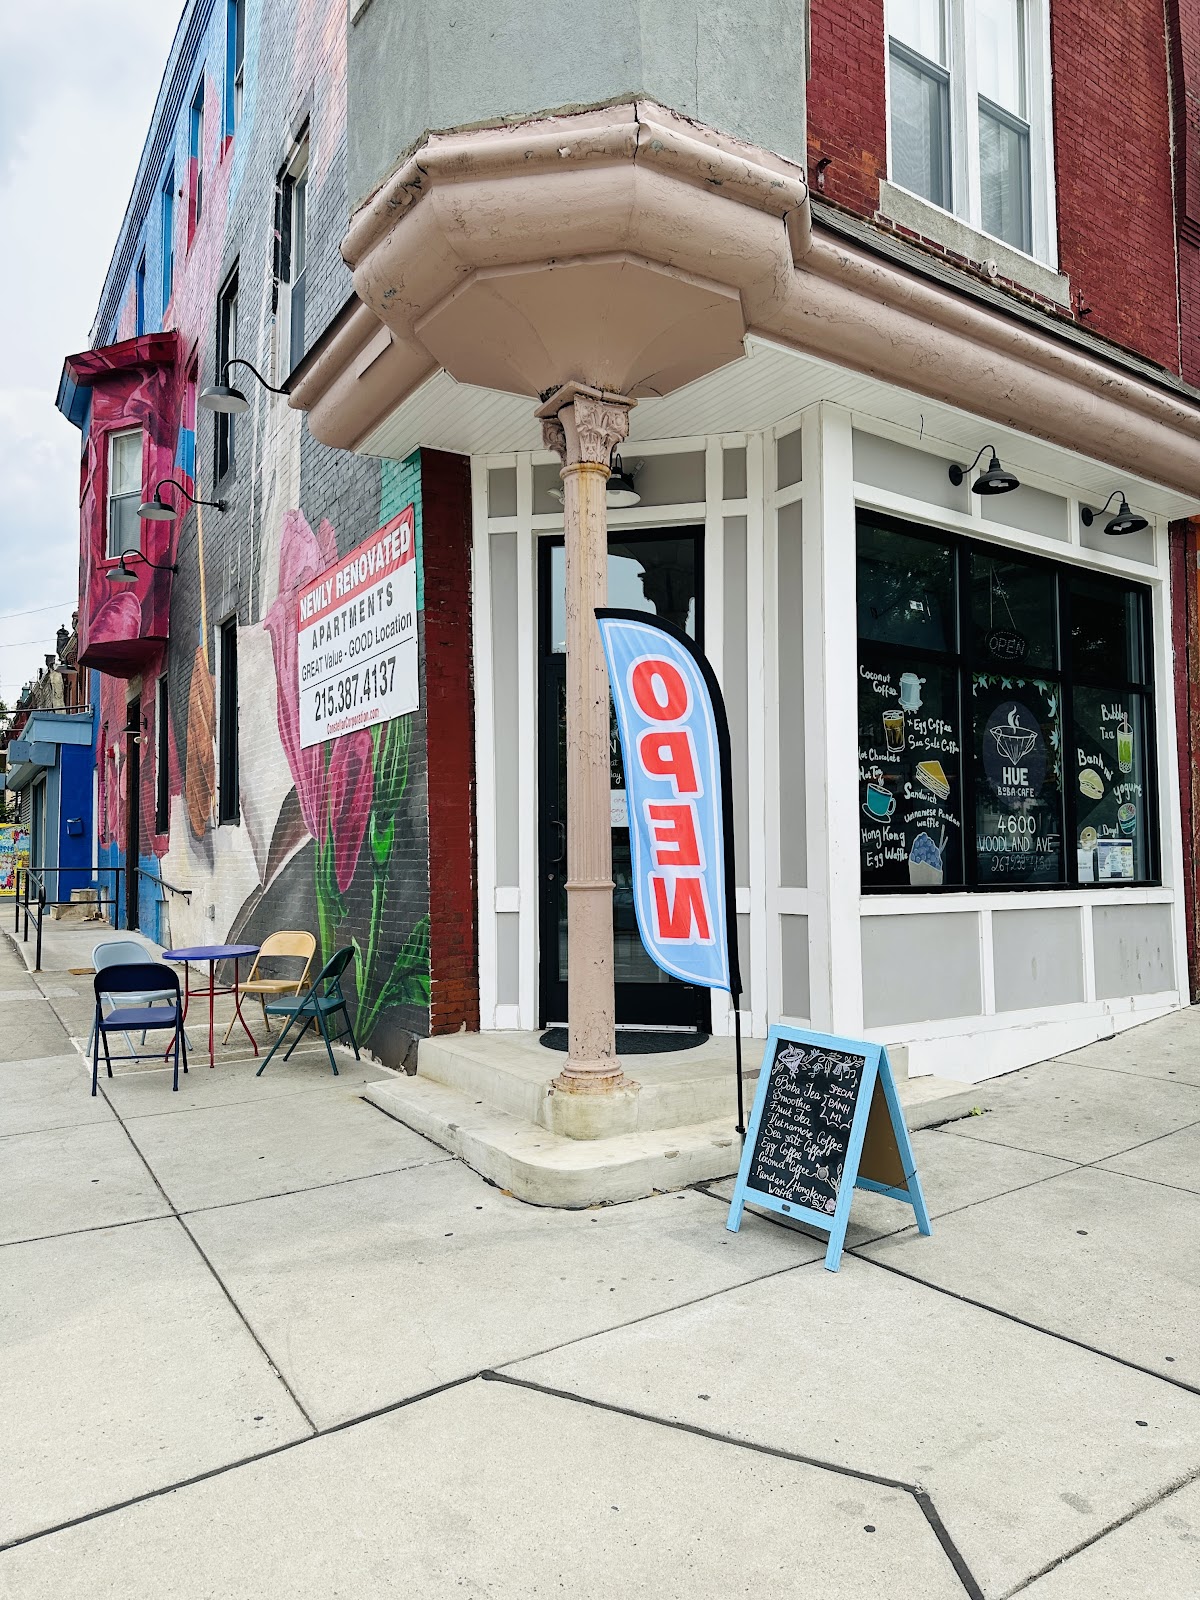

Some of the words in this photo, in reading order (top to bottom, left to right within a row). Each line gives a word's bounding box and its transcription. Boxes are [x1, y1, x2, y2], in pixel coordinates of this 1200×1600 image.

[300, 577, 333, 622] NEWLY
[335, 521, 411, 599] RENOVATED
[311, 581, 393, 650] APARTMENTS
[302, 656, 323, 682] GREAT
[324, 649, 343, 670] Value
[349, 629, 373, 658] GOOD
[375, 611, 412, 644] Location
[989, 636, 1026, 656] OPEN
[860, 665, 891, 683] Coconut
[315, 656, 396, 721] 215.387.4137
[873, 681, 898, 698] Coffee
[914, 719, 927, 735] Egg
[928, 718, 952, 735] Coffee
[1100, 726, 1115, 740] Tea
[908, 734, 924, 749] Sea
[868, 748, 901, 763] Chocolate
[1002, 766, 1029, 786] HUE
[904, 782, 937, 805] Sandwich
[997, 815, 1037, 834] 4600
[861, 828, 882, 849] Hong
[883, 826, 905, 847] Kong
[978, 836, 1030, 852] WOODLAND
[1035, 836, 1054, 852] AVE
[866, 851, 884, 868] Egg
[885, 847, 908, 862] Waffle
[775, 1075, 800, 1095] Boba
[803, 1083, 821, 1100] Tea
[829, 1084, 856, 1101] SPECIAL
[773, 1088, 812, 1111] Smoothie
[770, 1101, 792, 1117] Fruit
[794, 1108, 811, 1126] Tea
[765, 1124, 782, 1139] Sea
[760, 1137, 778, 1157] Egg
[780, 1142, 802, 1163] Coffee
[817, 1131, 843, 1156] Coffee
[756, 1165, 787, 1186] Pandan
